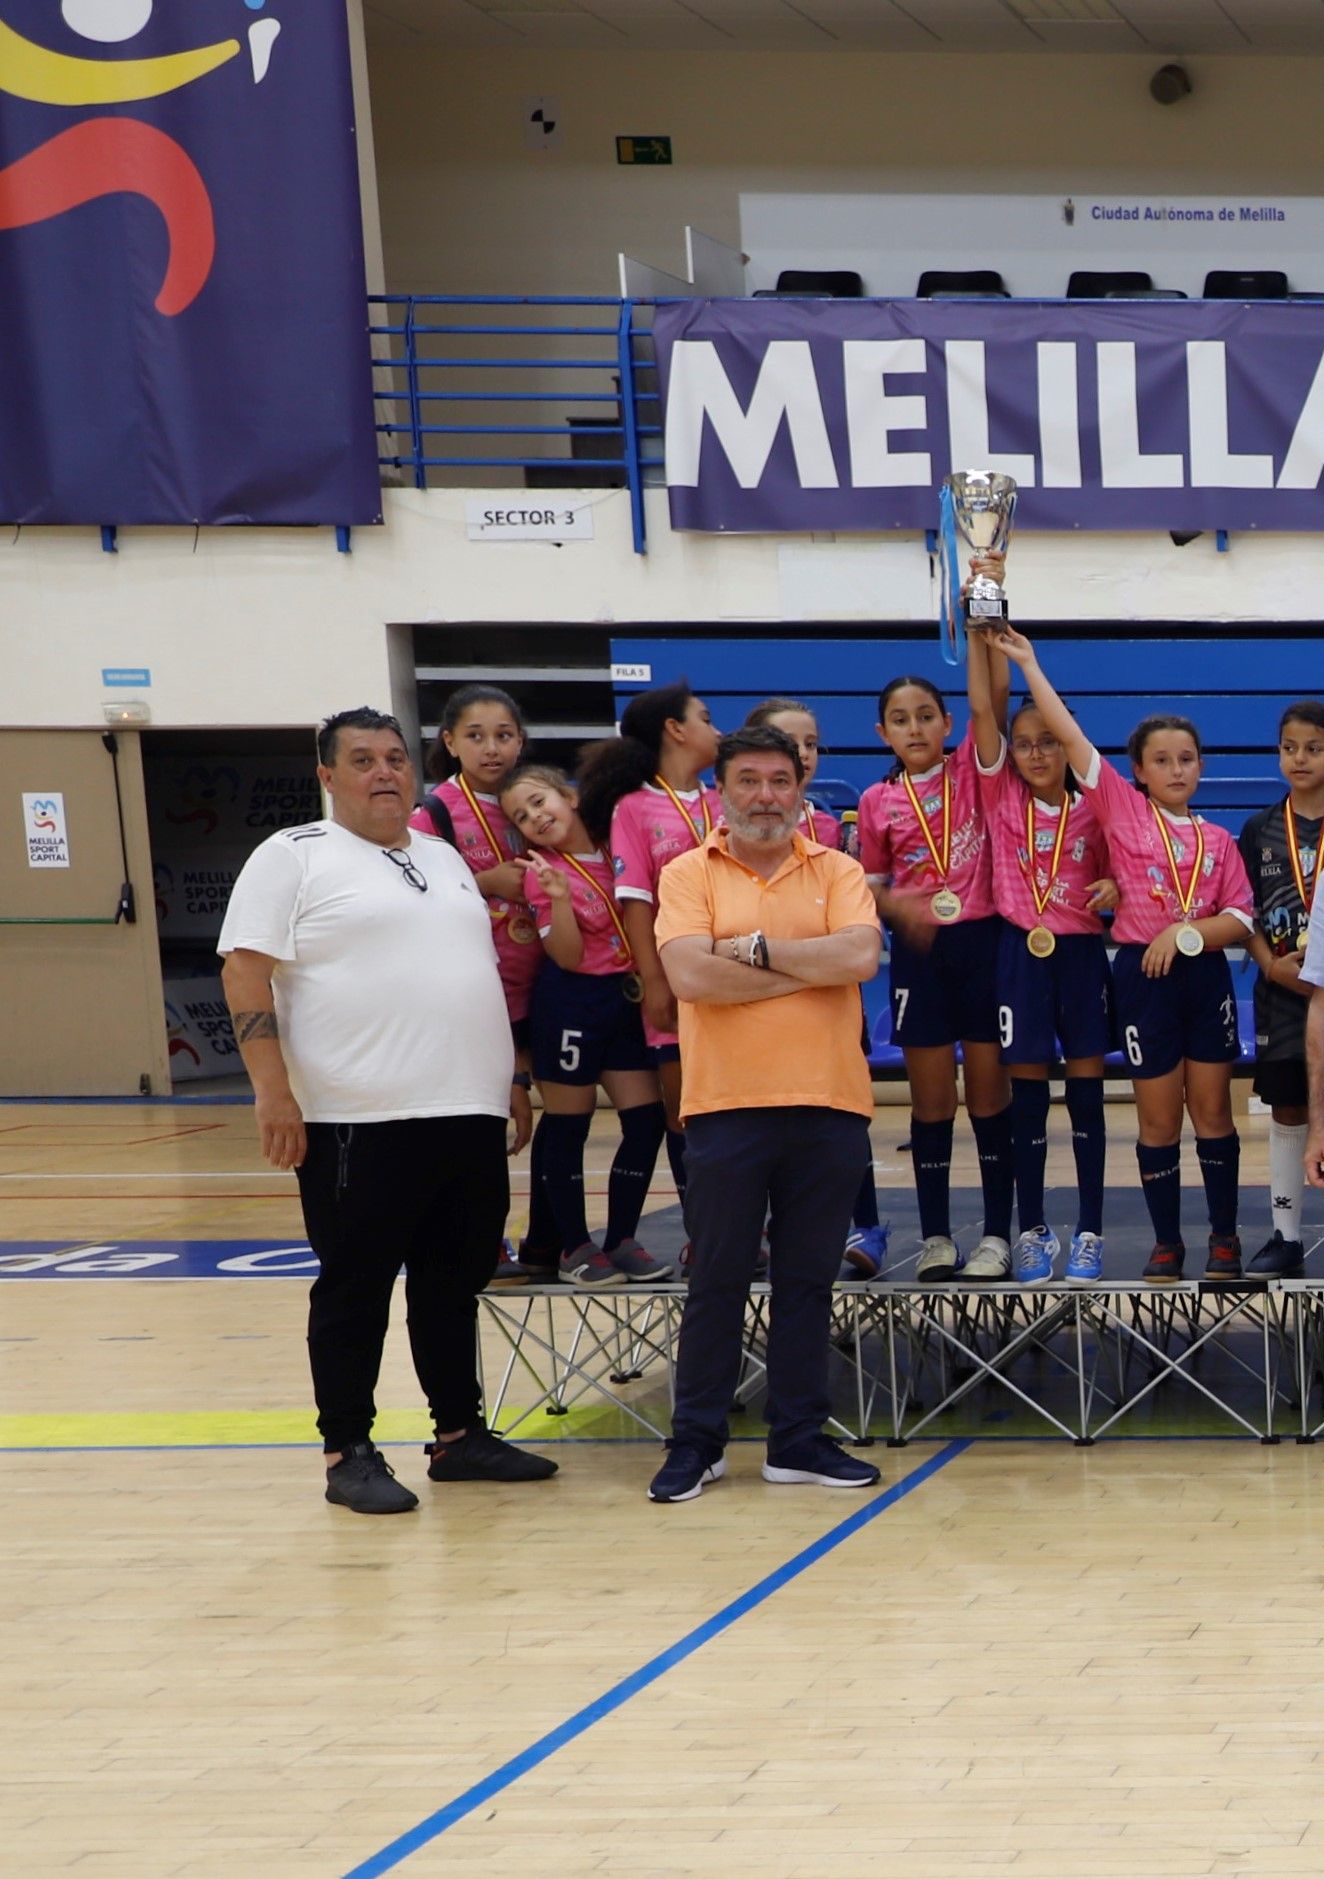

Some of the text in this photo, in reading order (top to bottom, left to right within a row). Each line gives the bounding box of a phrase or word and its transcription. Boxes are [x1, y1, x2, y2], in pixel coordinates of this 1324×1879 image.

[1092, 206, 1285, 222] Ciudad Autónoma de Melilla
[484, 510, 575, 526] SECTOR 3
[616, 668, 637, 676] FILA
[29, 837, 65, 845] MELILLA
[30, 845, 59, 854] SPORT
[31, 853, 67, 862] CAPITAL
[184, 887, 233, 899] SPOR
[186, 902, 228, 915] CAPI
[895, 988, 909, 1031] 7
[1000, 1005, 1013, 1048] 9
[560, 1029, 582, 1071] 5
[1125, 1025, 1143, 1066] 6
